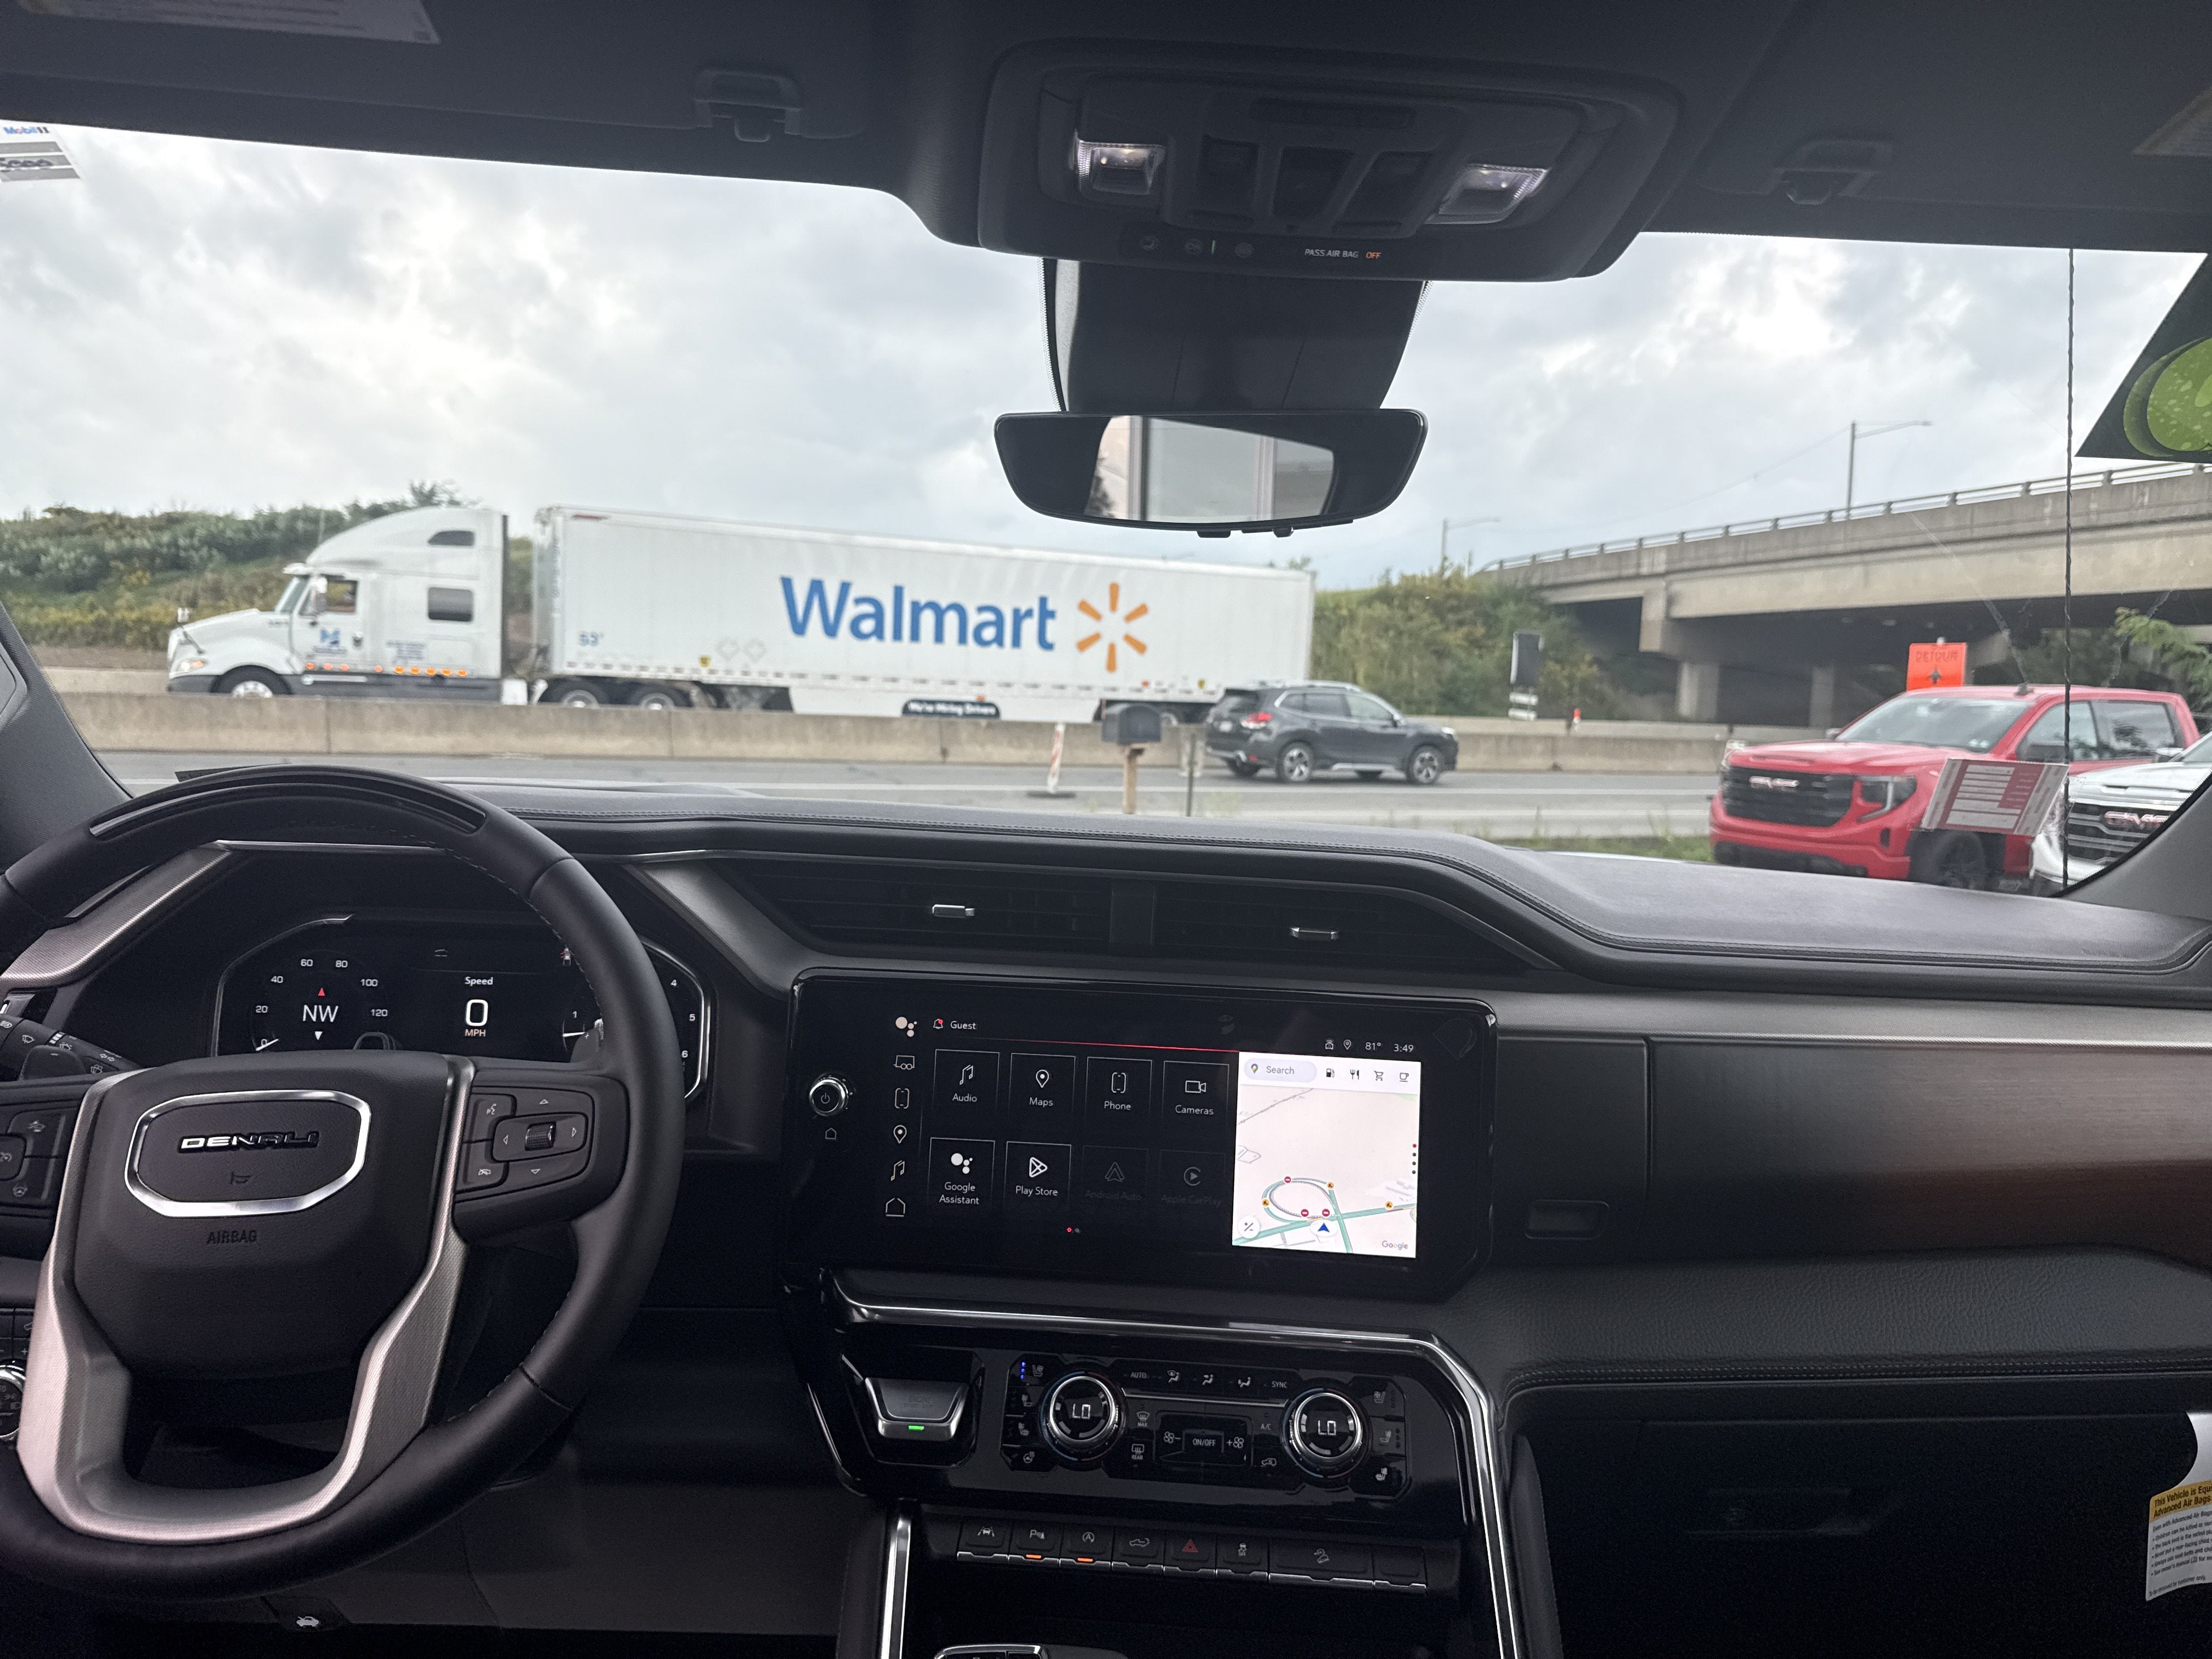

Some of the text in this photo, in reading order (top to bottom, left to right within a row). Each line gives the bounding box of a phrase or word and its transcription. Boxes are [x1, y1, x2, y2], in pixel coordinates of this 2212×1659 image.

[1305, 249, 1325, 257] PASS
[780, 576, 1057, 651] Walmart
[1916, 650, 1958, 663] DETOUR
[1749, 776, 1799, 793] GMC
[301, 959, 313, 967] 60
[335, 960, 348, 968] 80
[270, 975, 284, 984] 40
[360, 978, 378, 987] 100
[465, 977, 493, 987] Speed
[670, 979, 677, 987] 4
[256, 1005, 268, 1013] 20
[302, 1005, 338, 1022] NW
[370, 1008, 388, 1017] 120
[465, 999, 489, 1026] 0
[689, 1013, 696, 1022] 5
[950, 1020, 976, 1030] Guest
[465, 1028, 486, 1037] MPH
[1365, 1042, 1414, 1053] 81° 3:49
[1266, 1065, 1295, 1075] Search
[952, 1093, 977, 1102] Audio
[1029, 1097, 1053, 1107] Maps
[1104, 1101, 1131, 1111] Phone
[1175, 1104, 1214, 1116] Cameras
[179, 1131, 320, 1151] DENALI
[944, 1182, 976, 1194] Google
[1015, 1186, 1058, 1198] Play Store
[939, 1194, 979, 1205] Assistant
[1085, 1189, 1142, 1201] Android Auto
[1161, 1194, 1221, 1208] Apple CarPlay
[207, 1230, 258, 1244] AIRBAG
[1381, 1240, 1408, 1250] Google
[1072, 1403, 1091, 1419] LO
[1318, 1420, 1336, 1436] LO
[1192, 1438, 1216, 1447] ON/OFF
[2154, 1497, 2165, 1508] This
[2167, 1489, 2189, 1503] Vehicle
[2191, 1487, 2197, 1496] is
[2153, 1496, 2211, 1519] Advanced Air Bags
